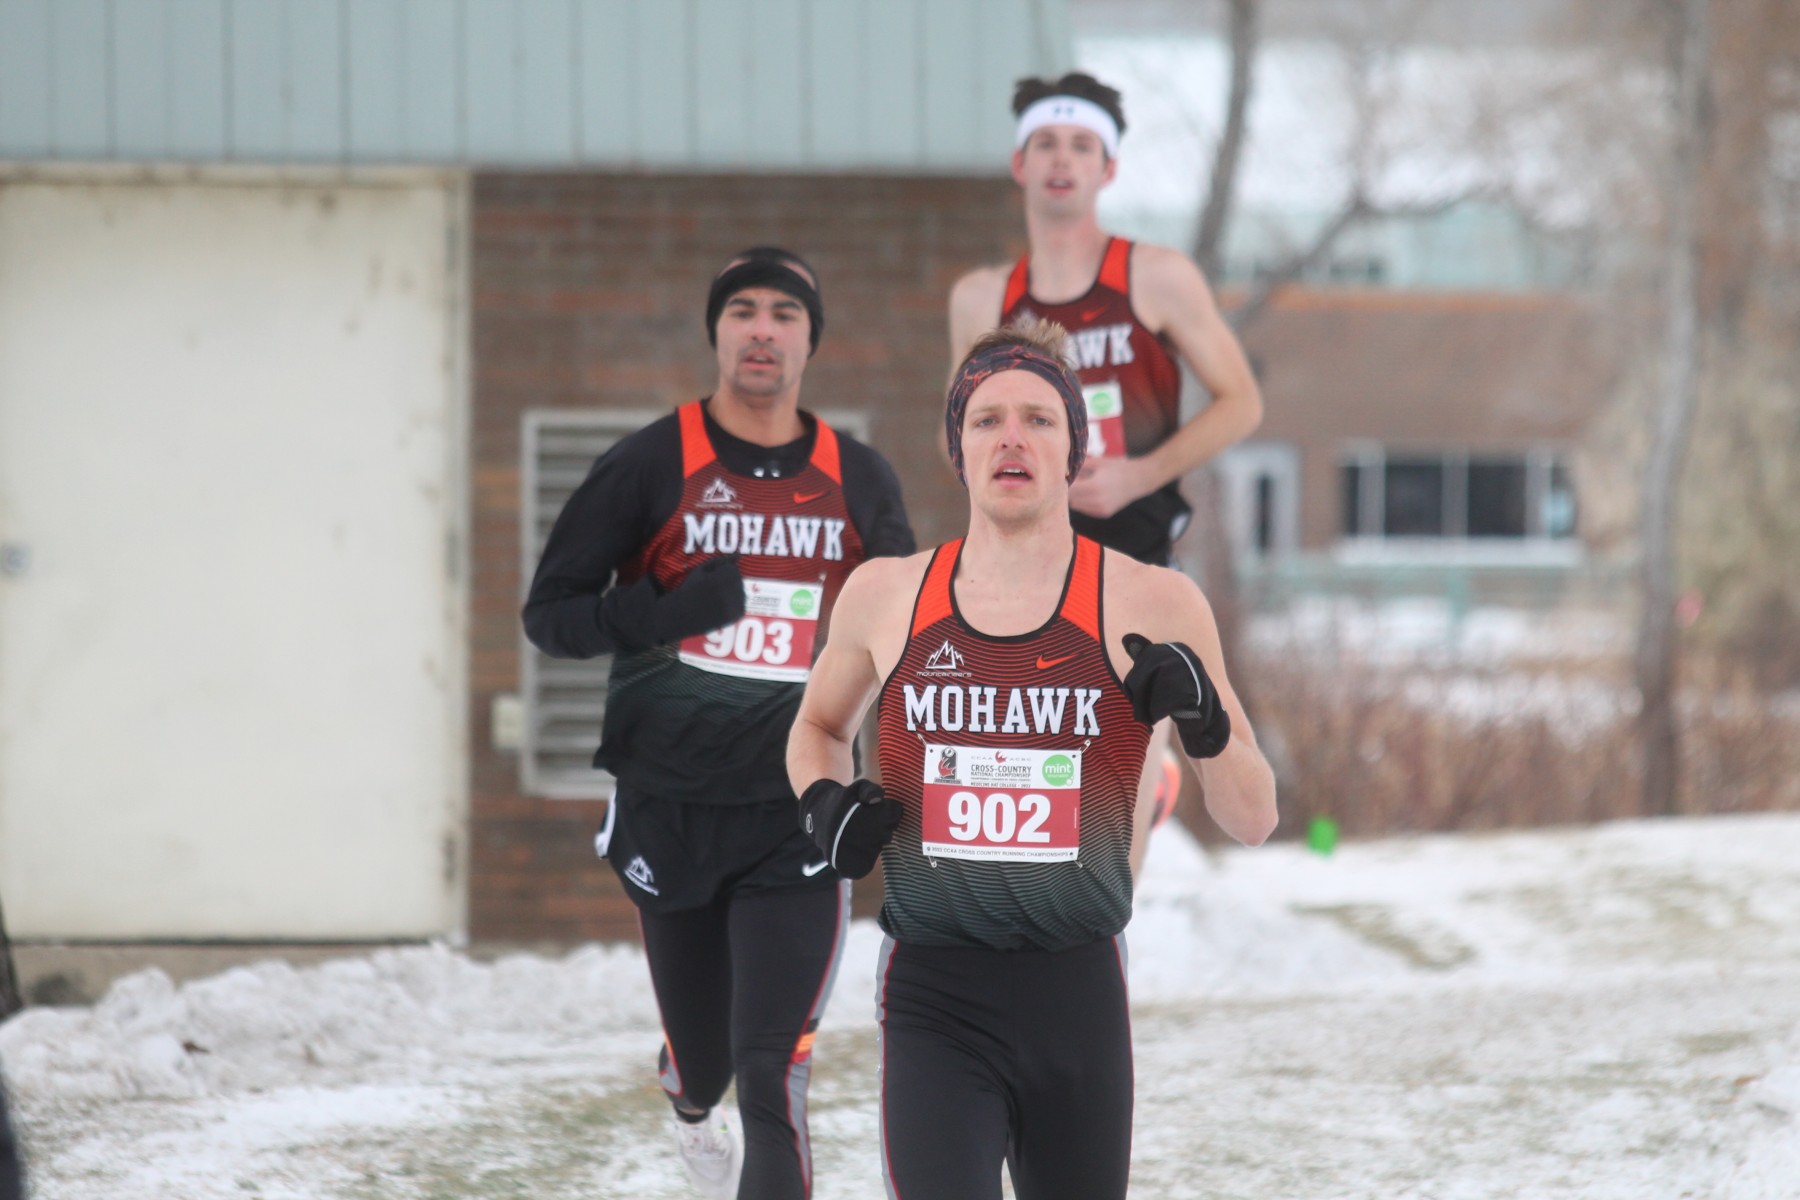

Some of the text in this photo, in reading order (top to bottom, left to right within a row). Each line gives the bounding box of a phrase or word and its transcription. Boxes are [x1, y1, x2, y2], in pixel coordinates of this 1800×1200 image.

[683, 512, 846, 561] MOHAWK
[703, 617, 793, 665] 903
[903, 684, 1102, 736] MOHAWK
[971, 764, 1032, 774] CROSS-COUNTRY
[1045, 763, 1072, 774] mint
[948, 791, 1051, 843] 902
